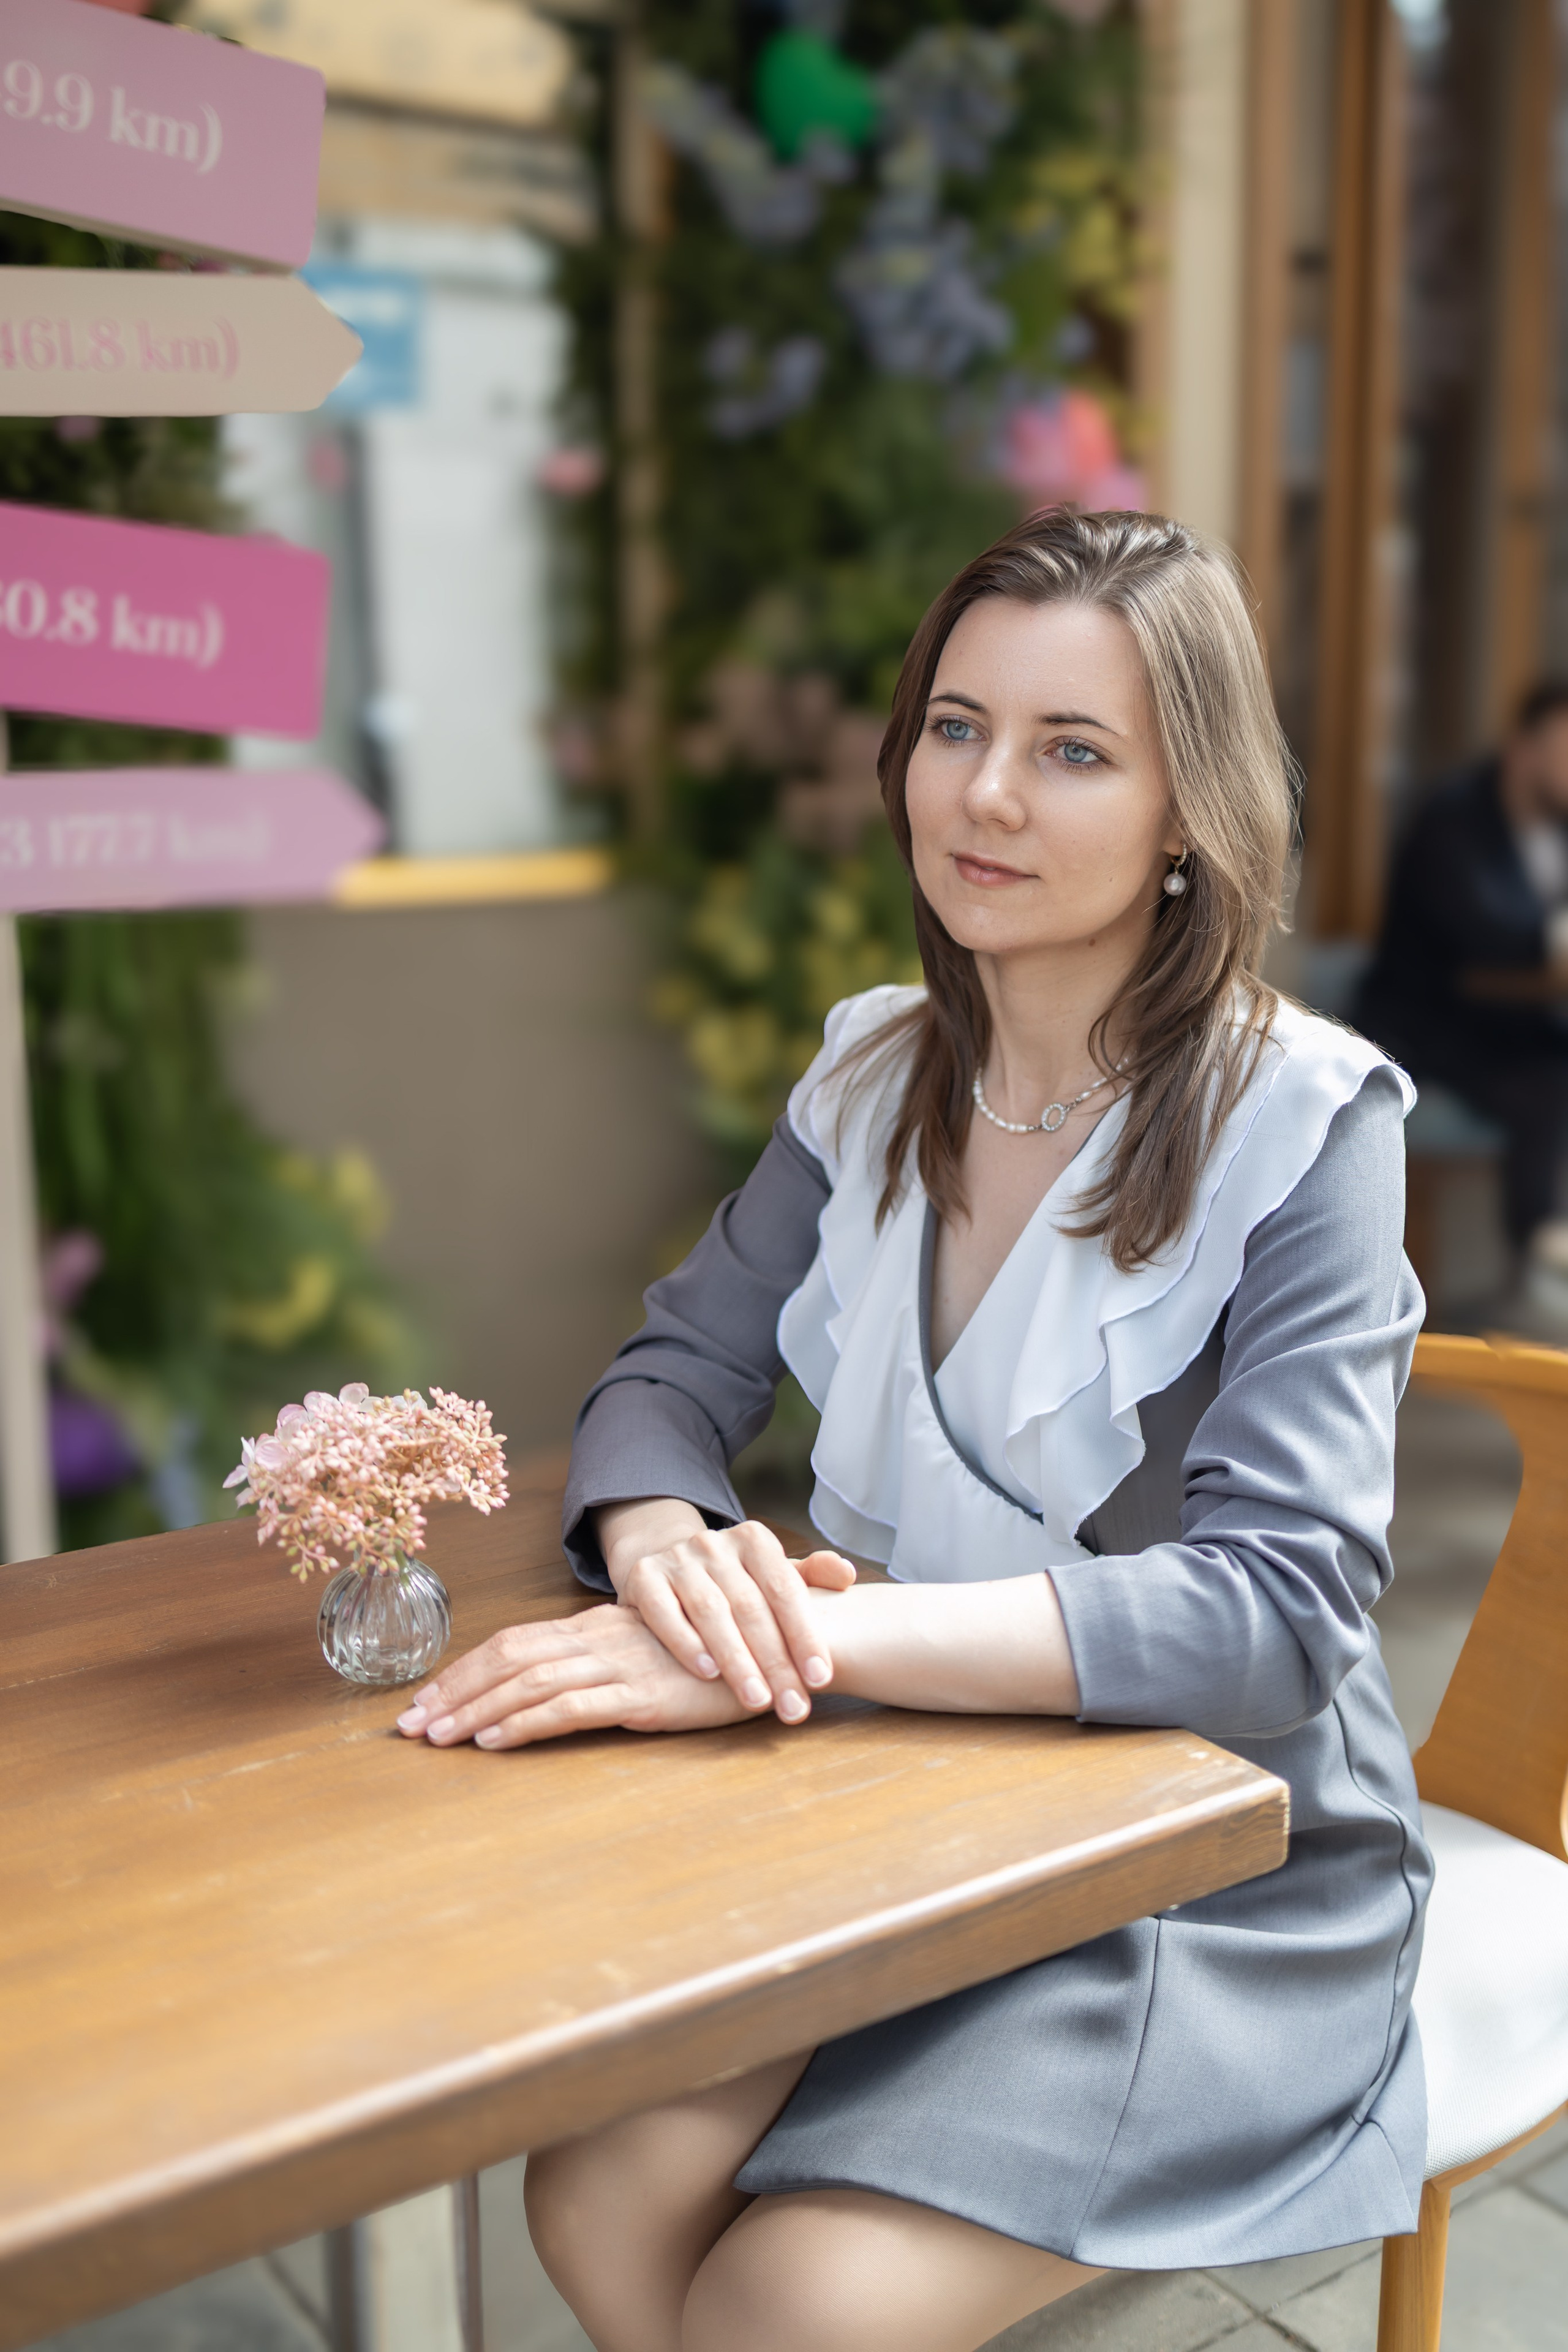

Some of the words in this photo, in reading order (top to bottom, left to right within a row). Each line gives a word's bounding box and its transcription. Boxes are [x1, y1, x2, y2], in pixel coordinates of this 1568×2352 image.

[0, 59, 94, 134] 9.9
[108, 85, 224, 176] km)
[135, 315, 241, 380] km)
[0, 578, 100, 648] 0.8
[110, 592, 225, 671] km)
